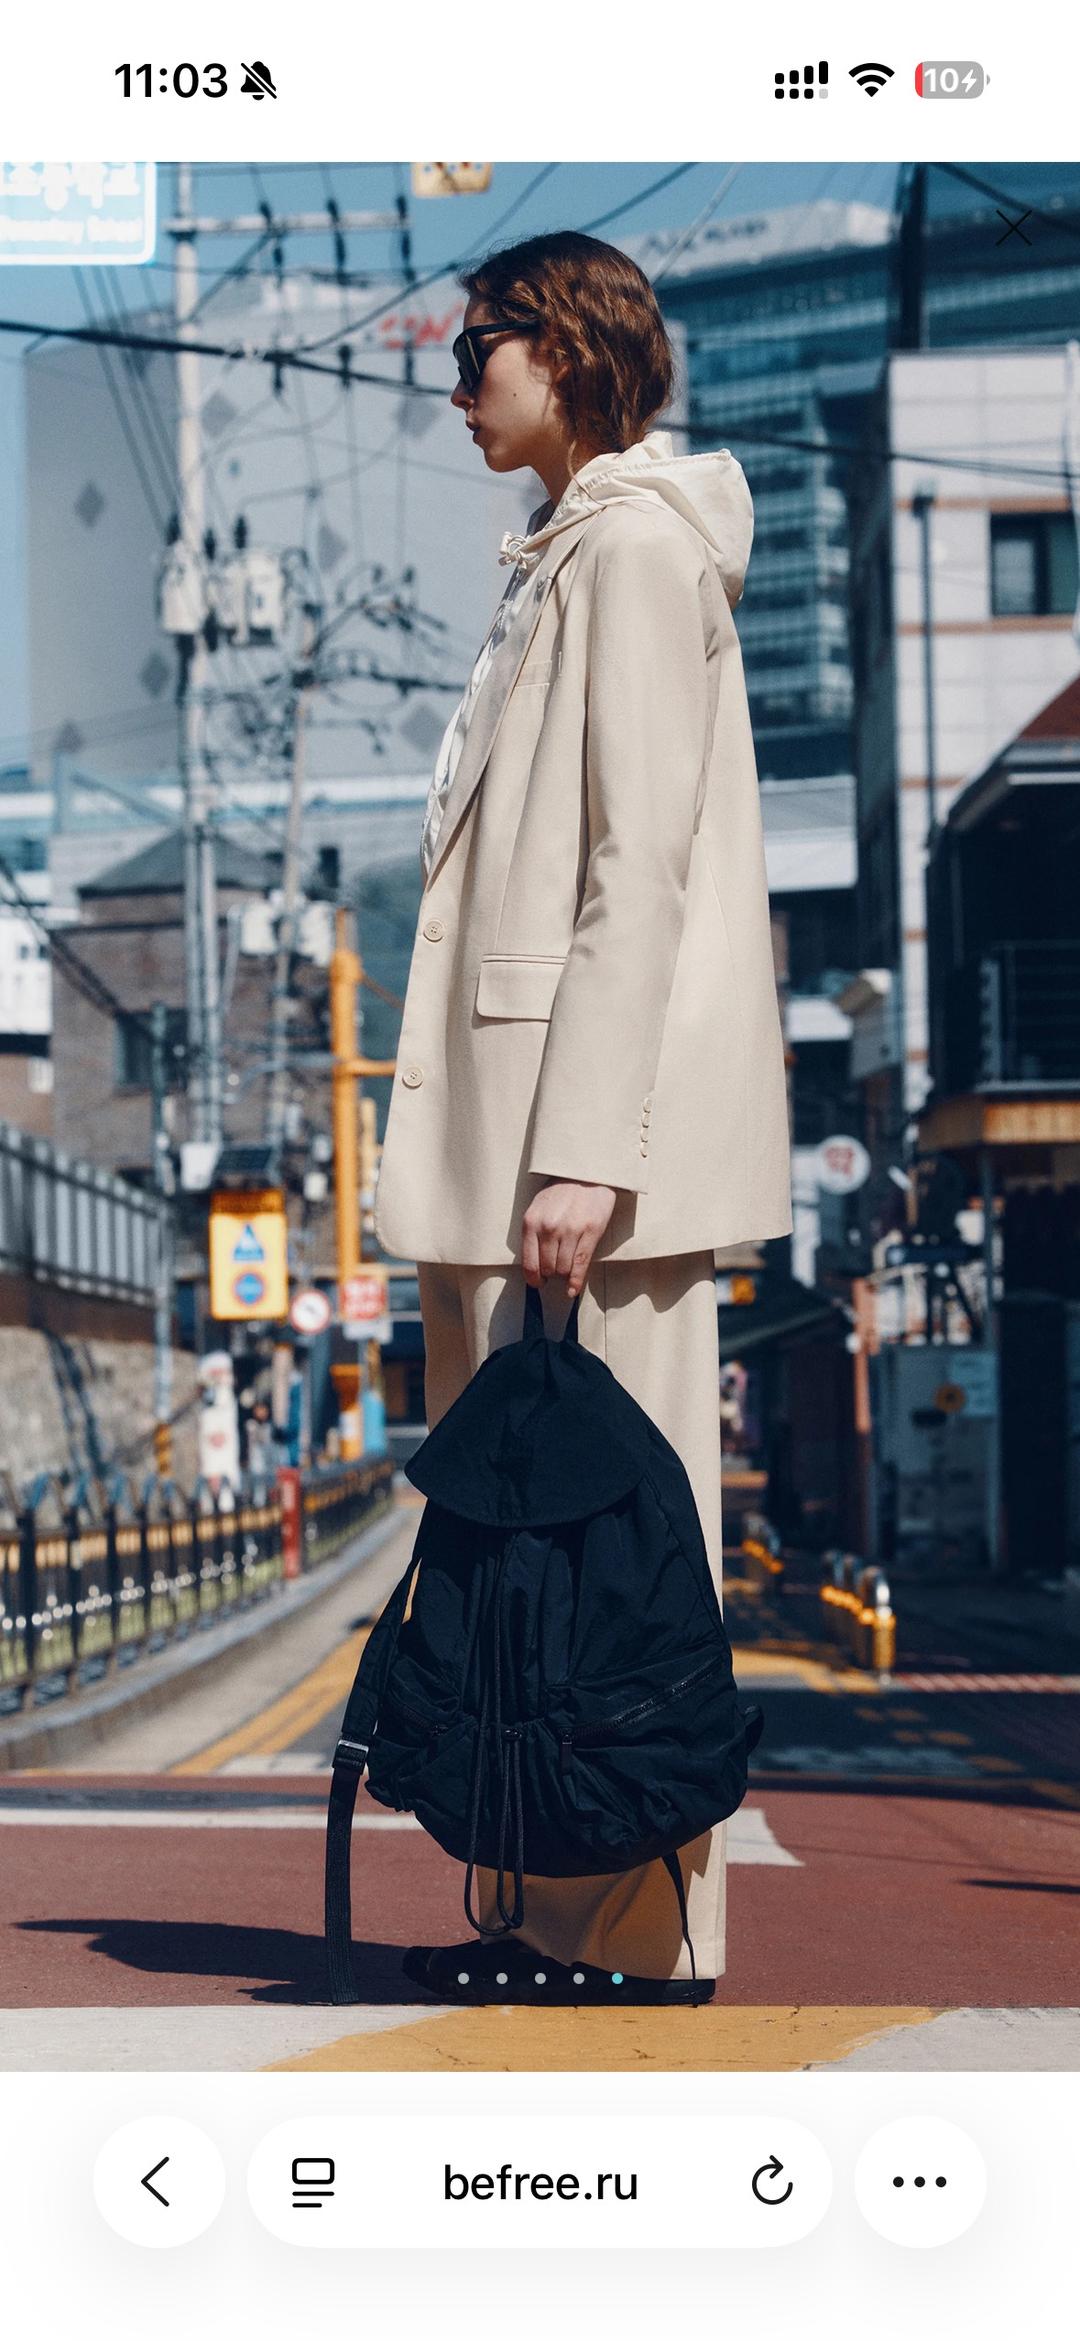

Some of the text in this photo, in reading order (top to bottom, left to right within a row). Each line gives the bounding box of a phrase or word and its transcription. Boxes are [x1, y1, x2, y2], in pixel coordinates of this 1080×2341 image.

[114, 62, 228, 99] 11:03
[924, 67, 960, 93] 10
[444, 2163, 637, 2201] befree.ru
